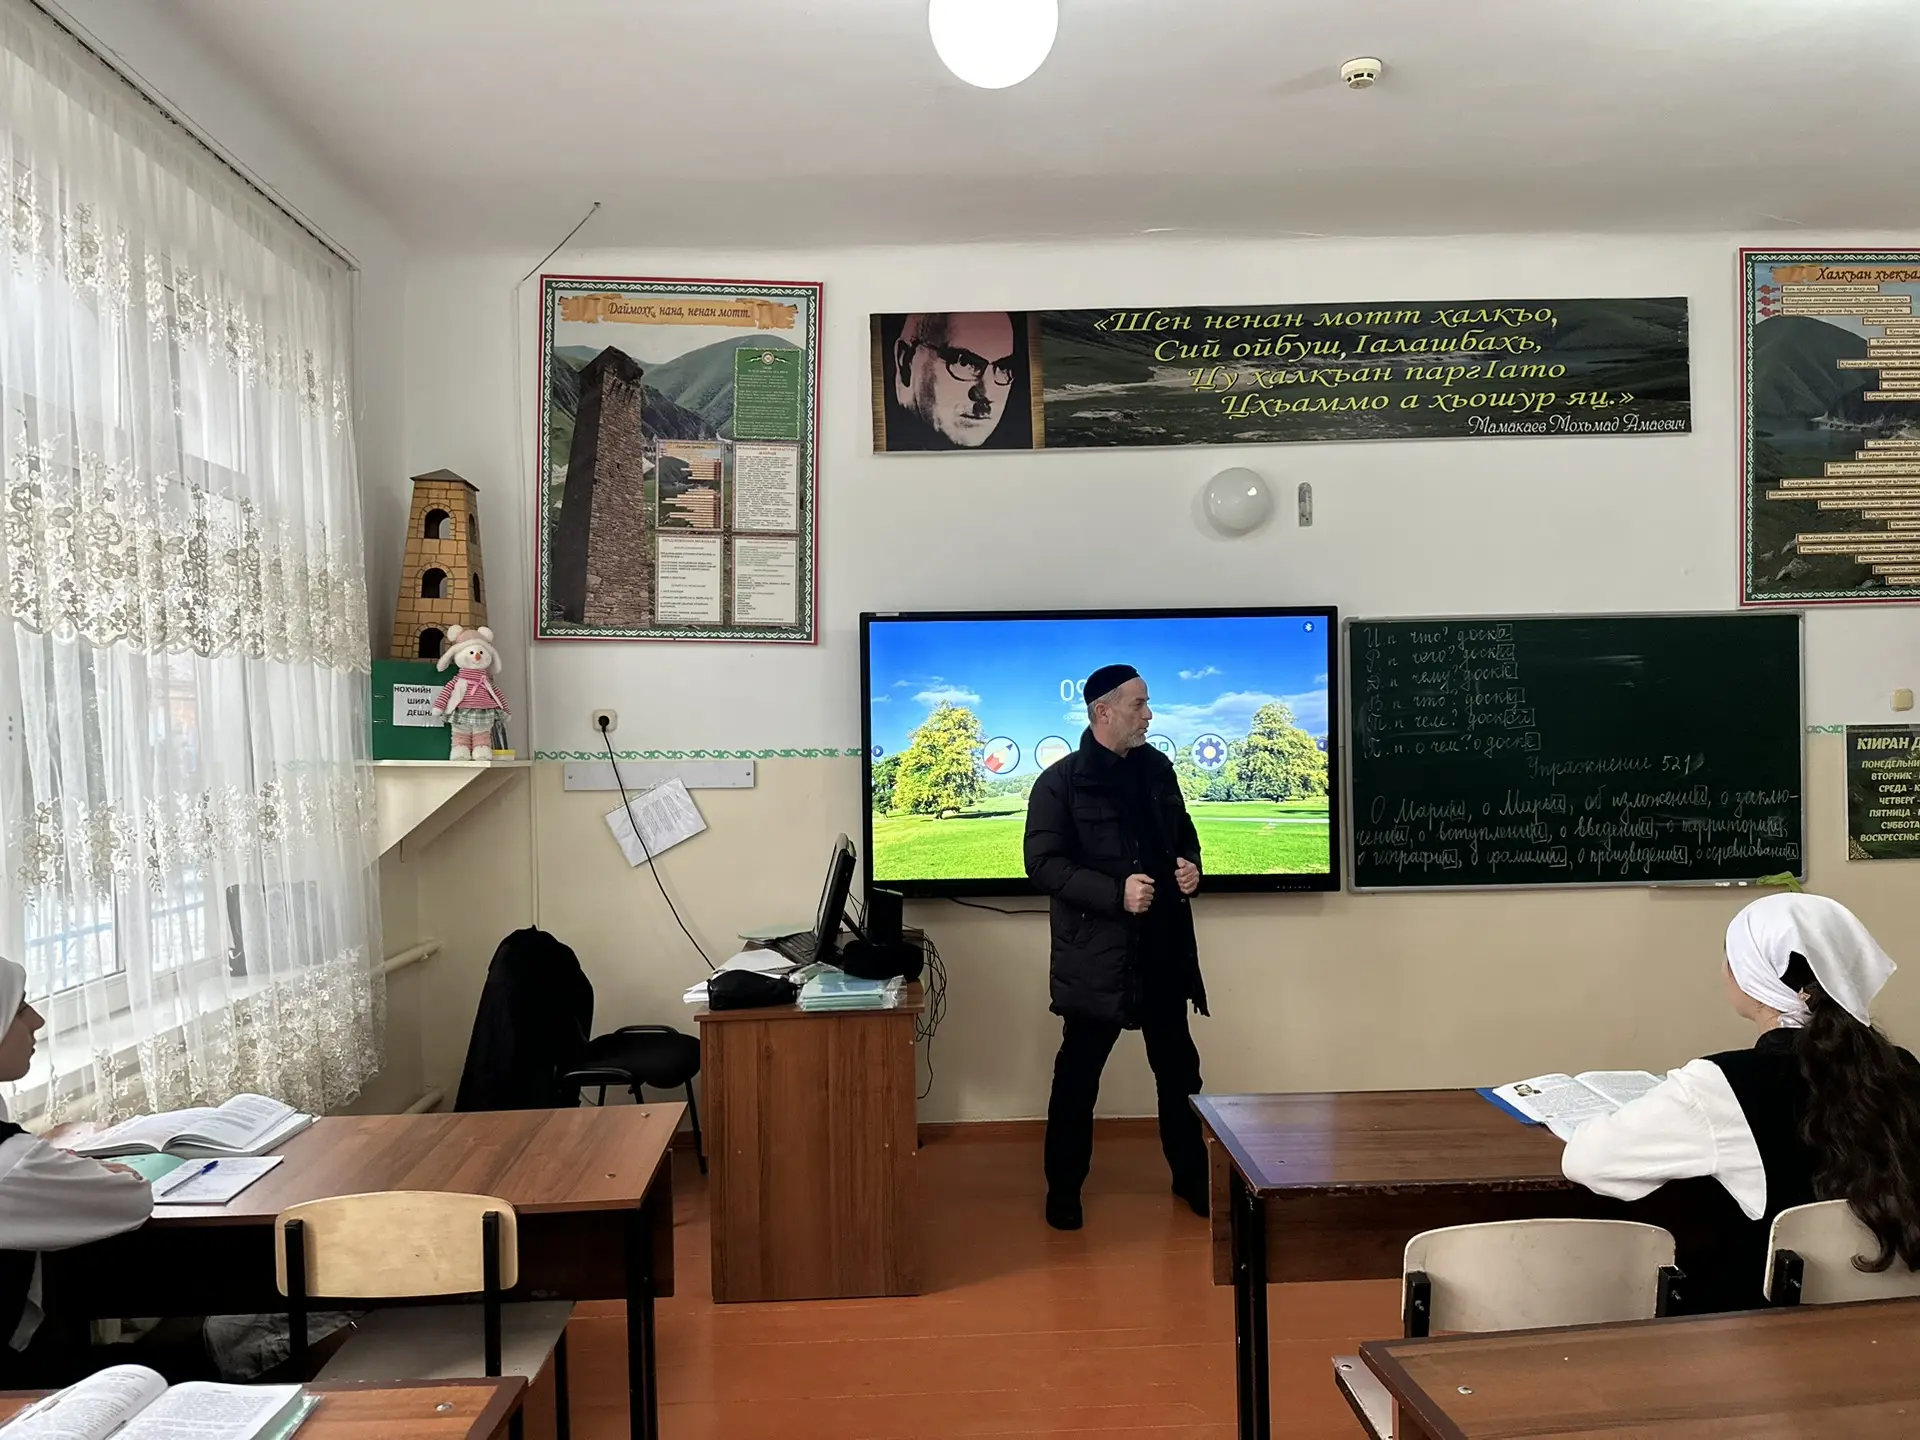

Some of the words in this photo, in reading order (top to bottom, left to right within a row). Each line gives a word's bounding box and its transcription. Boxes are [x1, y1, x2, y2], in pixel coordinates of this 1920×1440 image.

[1816, 266, 1871, 283] Халкъан
[659, 306, 684, 318] нана,
[687, 307, 716, 317] ненан
[718, 308, 751, 318] мотт.
[1093, 310, 1192, 332] «Шен
[1204, 311, 1304, 329] ненан
[1313, 308, 1421, 326] мотт
[1430, 307, 1558, 328] халкъо,
[1154, 338, 1222, 362] Сий
[1233, 333, 1346, 363] ойбуш,
[1188, 365, 1239, 393] Цу
[1247, 365, 1393, 388] халкъан
[1221, 393, 1390, 420] Цхьаммо
[1400, 394, 1421, 410] а
[1429, 390, 1556, 414] хьошур
[1467, 415, 1547, 434] Мамакаев
[1549, 414, 1620, 433] Мохьмад
[1622, 413, 1686, 433] Амаевич
[1410, 626, 1449, 644] что?
[1457, 623, 1513, 650] доска
[1412, 645, 1455, 664] чего?
[1459, 644, 1515, 673] доски
[1460, 662, 1518, 692] доске
[394, 686, 432, 694] НОХЧИЙН
[1465, 687, 1525, 714] доску
[407, 709, 432, 717] ДЕШН
[1468, 708, 1536, 731] доской
[1527, 756, 1652, 786] Упражнение
[1662, 755, 1691, 775] 521
[1871, 772, 1912, 781] ВТОРНИК
[1585, 784, 1606, 810] об
[1878, 784, 1907, 794] СРЕДА
[1879, 796, 1915, 805] ЧЕТВЕРГ
[1869, 808, 1911, 818] ПЯТНИЦА
[1881, 821, 1920, 829] СУББОТА
[1860, 833, 1920, 842] ВОСКРЕСЕНЬЕ
